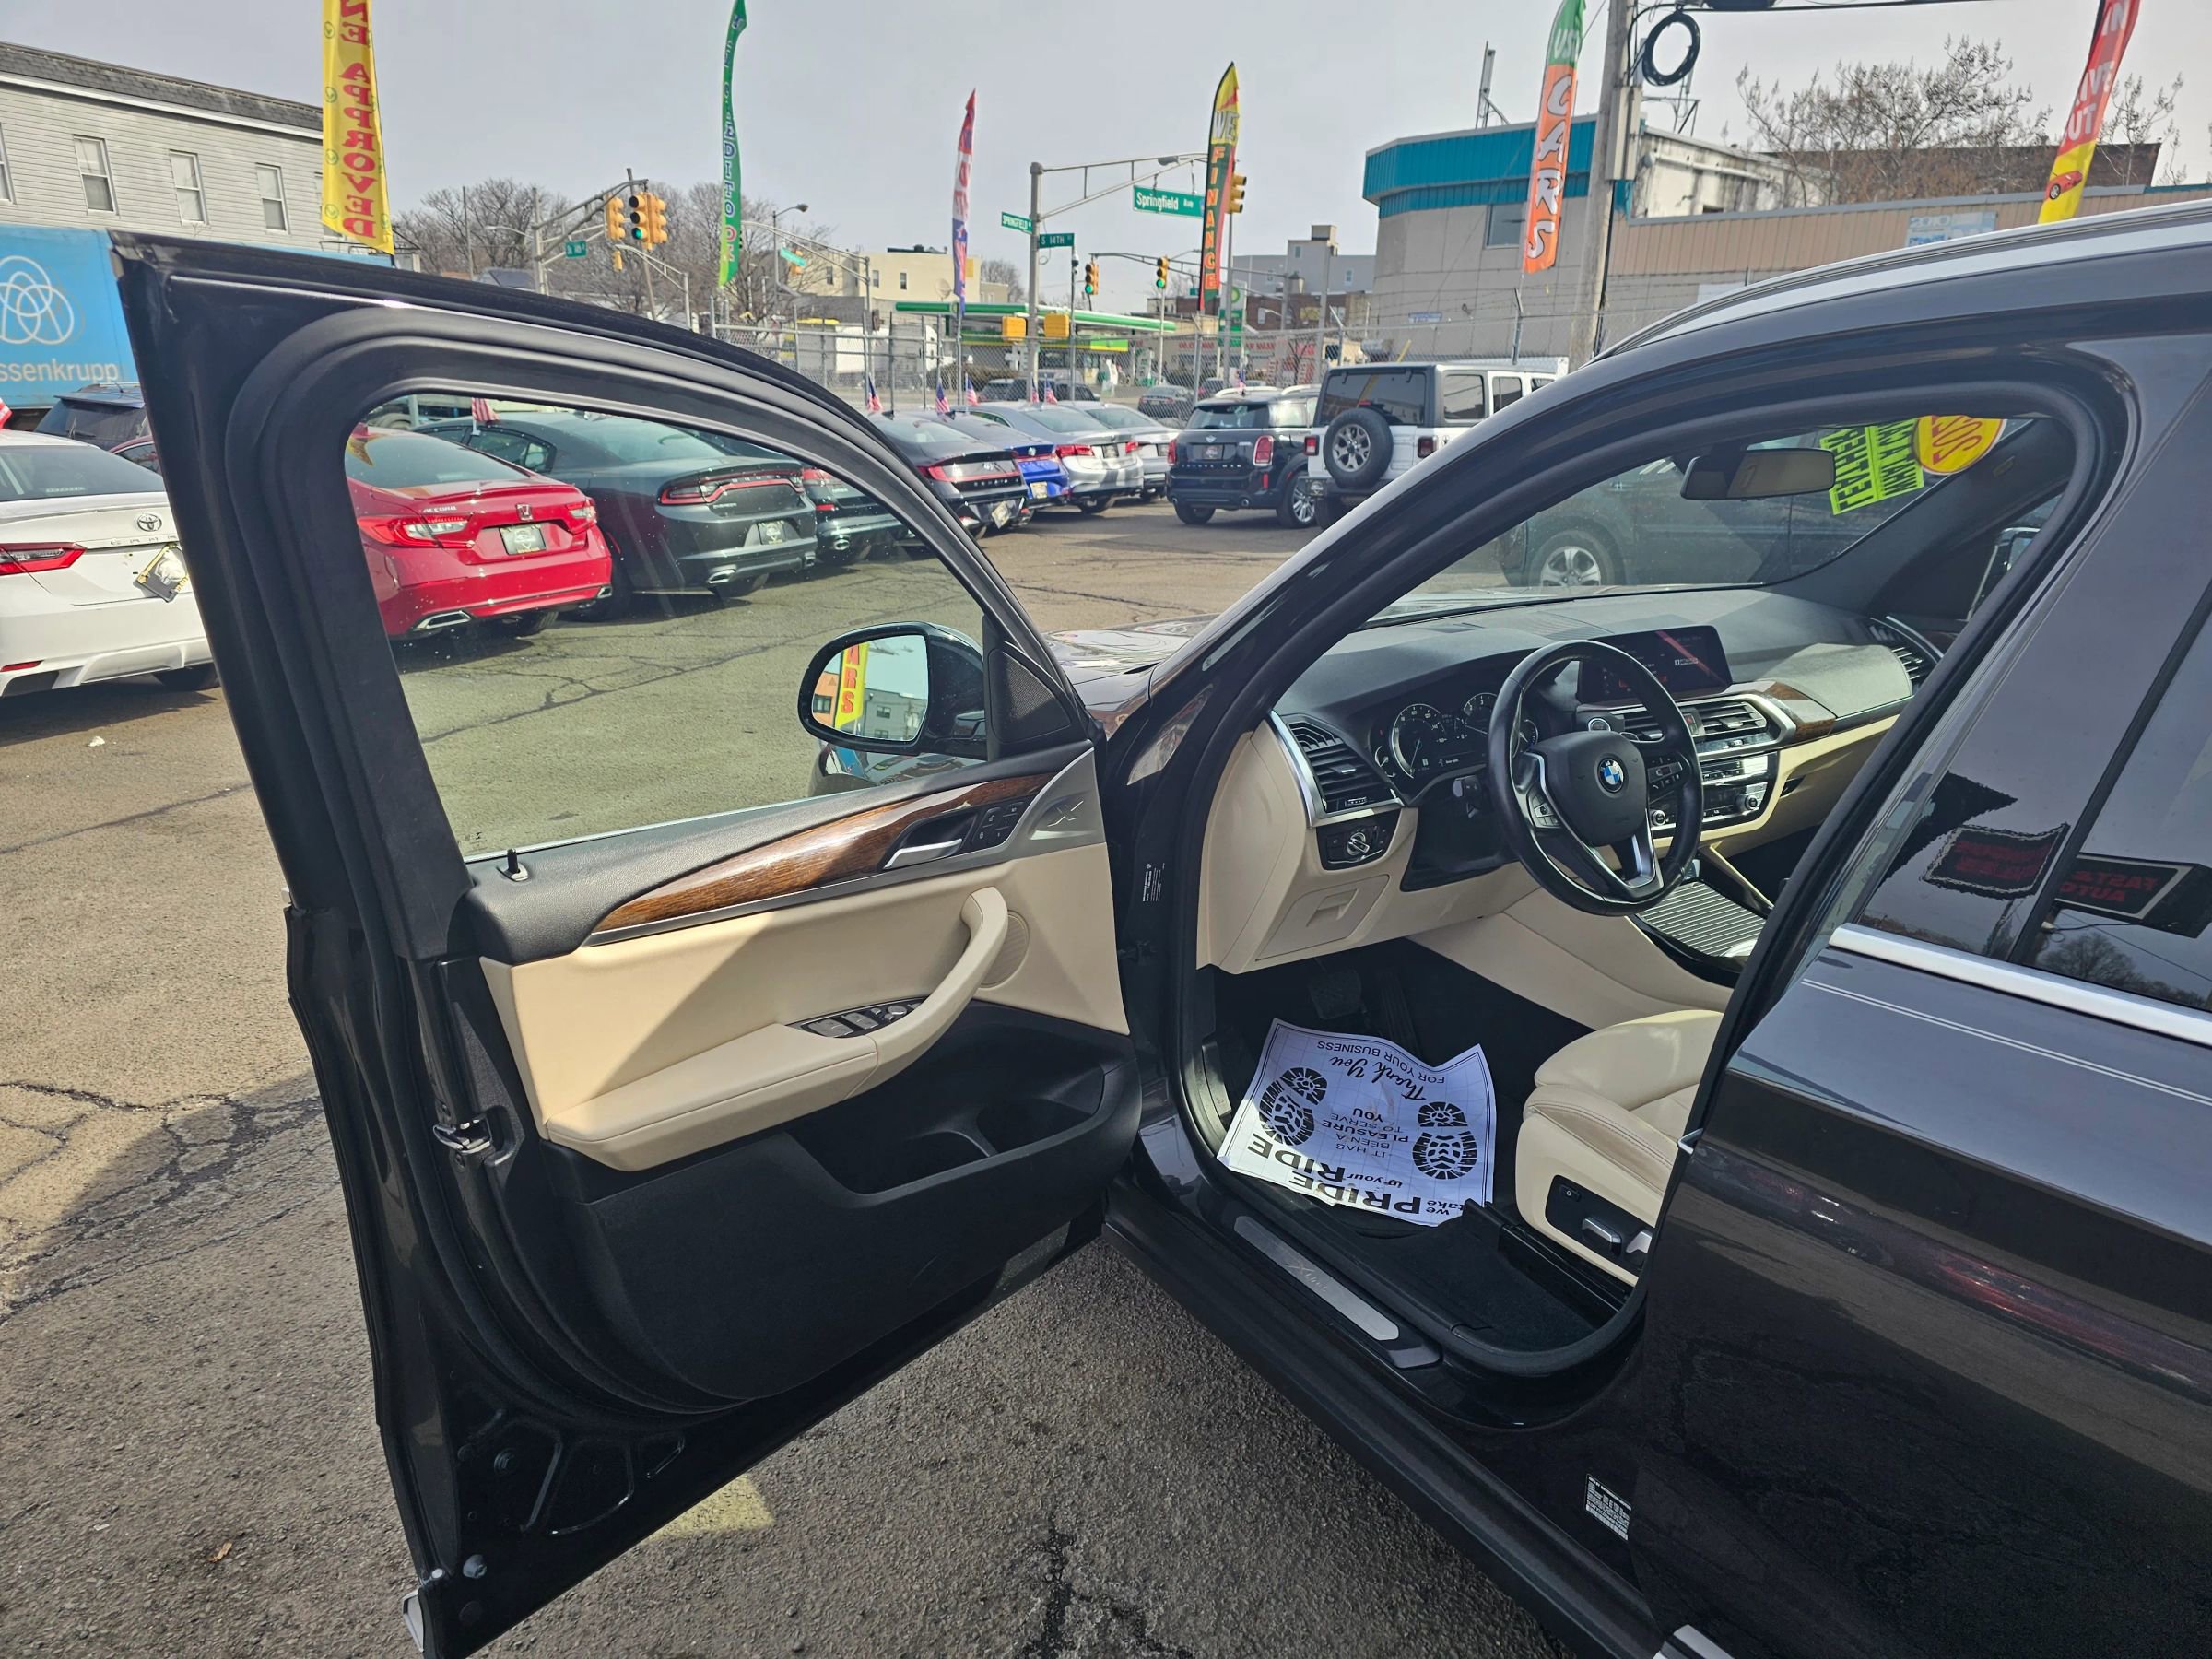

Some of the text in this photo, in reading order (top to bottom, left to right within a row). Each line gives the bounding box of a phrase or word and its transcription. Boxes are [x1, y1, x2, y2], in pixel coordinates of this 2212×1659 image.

[1212, 111, 1240, 140] WE
[2063, 102, 2098, 142] UT
[1527, 74, 1572, 260] CARS
[1136, 192, 1179, 211] Springfield
[1205, 146, 1226, 289] FINANCE
[1041, 236, 1046, 245] S
[0, 358, 119, 382] ssenkrupp
[1317, 1041, 1445, 1084] FOR YOUR BUSINESS
[1329, 1056, 1427, 1101] Thank You
[1331, 1113, 1403, 1134] TO SERVE
[1352, 1108, 1383, 1123] YOU
[1322, 1119, 1408, 1142] PLEASURE
[1335, 1133, 1390, 1150] BEEN A
[1247, 1133, 1346, 1182] RIDE
[1335, 1143, 1386, 1159] IT HAS
[1346, 1171, 1384, 1185] your
[1288, 1171, 1421, 1215] PRIDE
[1426, 1206, 1450, 1216] we
[1427, 1200, 1465, 1211] take
